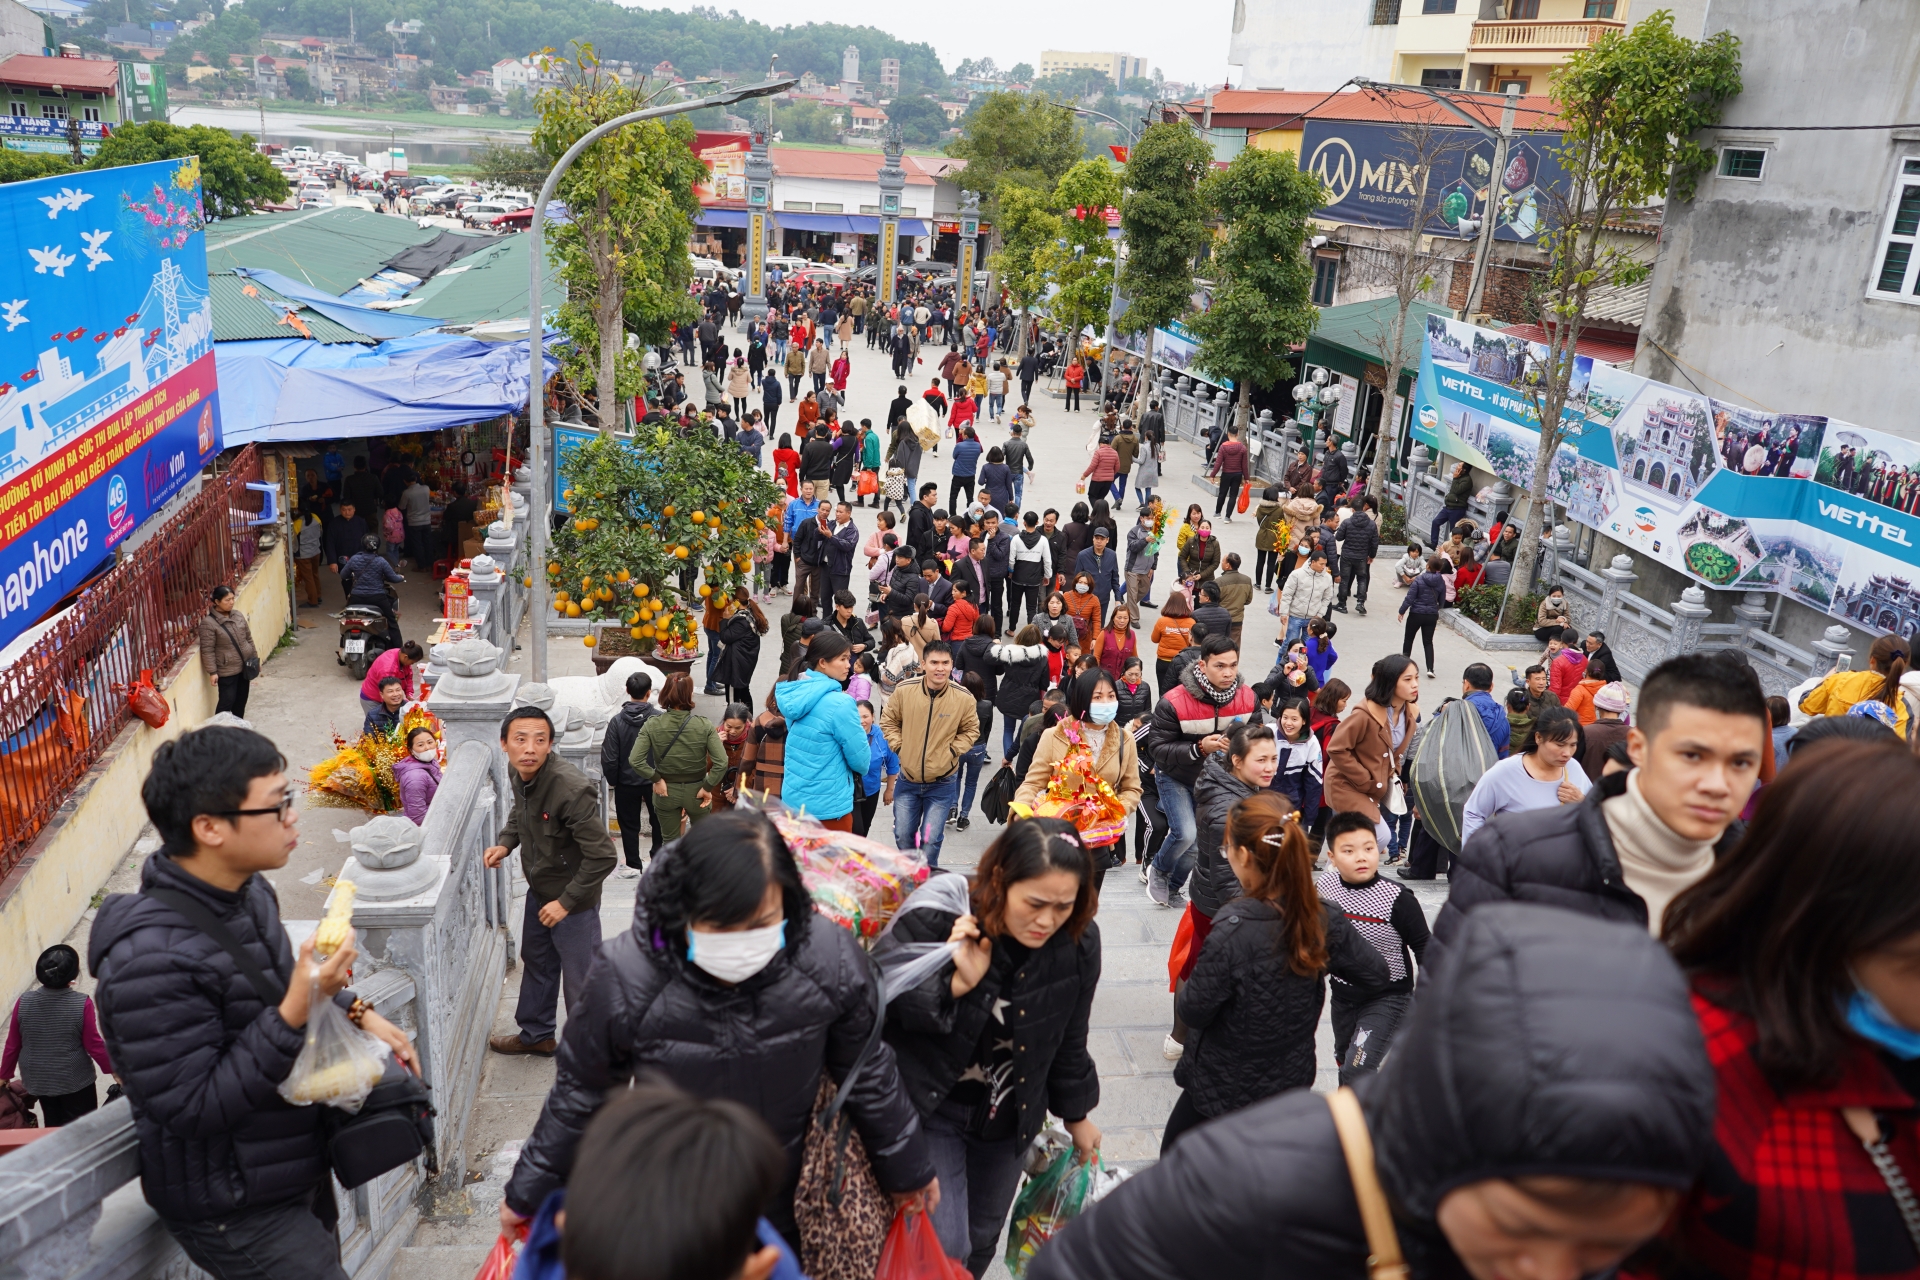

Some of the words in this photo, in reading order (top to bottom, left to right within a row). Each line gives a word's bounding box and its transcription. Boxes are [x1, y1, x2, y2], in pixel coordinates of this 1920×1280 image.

[1358, 191, 1377, 203] Trang
[1387, 197, 1409, 208] phong
[1441, 374, 1486, 401] VIETTEL
[1492, 392, 1500, 406] VÌ
[1499, 395, 1511, 411] SỰ
[30, 468, 44, 492] VŨ
[44, 460, 66, 484] NINH
[66, 448, 78, 467] RA
[78, 437, 94, 460] SỨC
[94, 429, 106, 449] THI
[106, 420, 121, 441] ĐUA
[120, 411, 134, 431] LẬP
[133, 397, 154, 421] THÀNH
[154, 388, 167, 408] TÍCH
[4, 510, 28, 541] TIẾN
[28, 499, 43, 524] TỚI
[43, 489, 60, 512] ĐẠI
[59, 477, 74, 501] HỘI
[74, 468, 89, 490] ĐẠI
[88, 452, 106, 480] BIỂU
[105, 442, 125, 467] TOÀN
[124, 427, 142, 454] QUỐC
[141, 419, 155, 441] LẦN
[175, 395, 187, 416] CỦA
[186, 387, 200, 408] ĐẢNG
[109, 482, 124, 507] 4G
[1634, 512, 1658, 527] VIETTEL
[1818, 498, 1914, 548] VIETTEL
[0, 518, 88, 620] aphone
